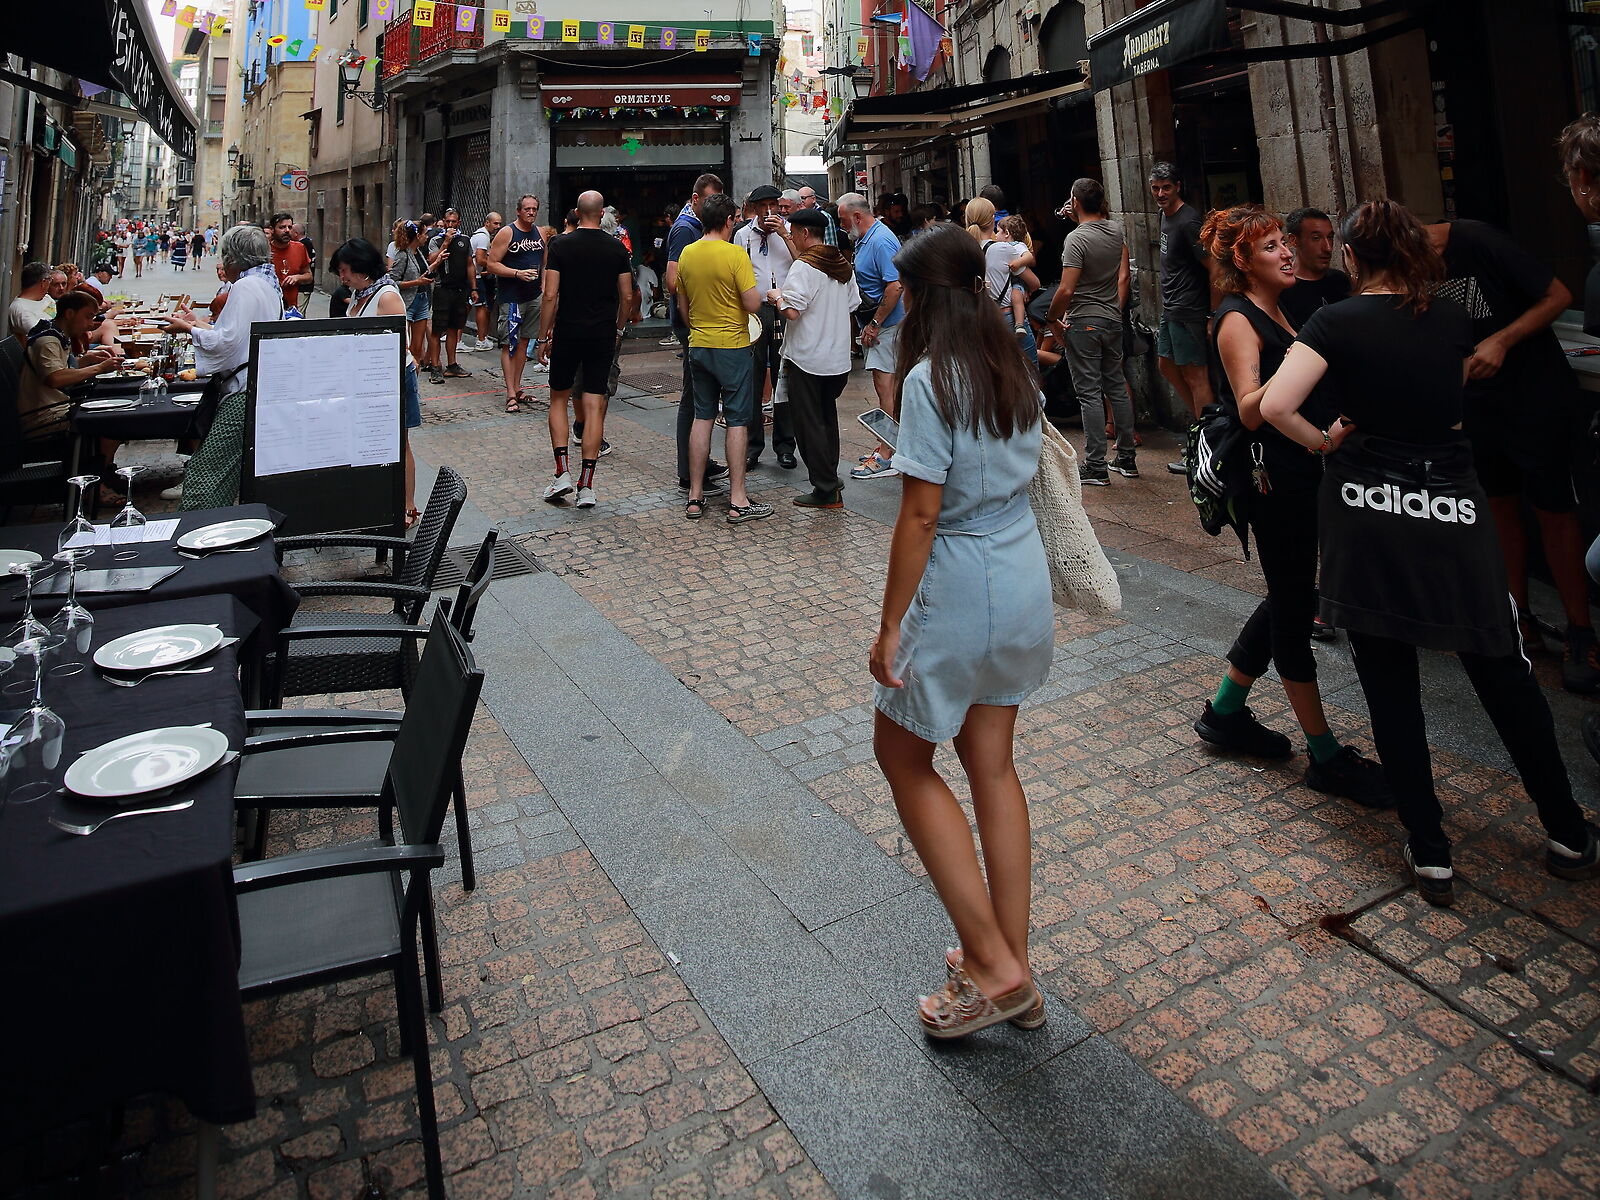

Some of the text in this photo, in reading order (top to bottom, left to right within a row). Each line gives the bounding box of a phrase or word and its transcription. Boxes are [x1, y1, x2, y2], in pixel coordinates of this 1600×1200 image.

[1122, 21, 1170, 69] ARDIBELTZ
[614, 94, 671, 104] ORMAETXE
[1341, 482, 1476, 525] adidas
